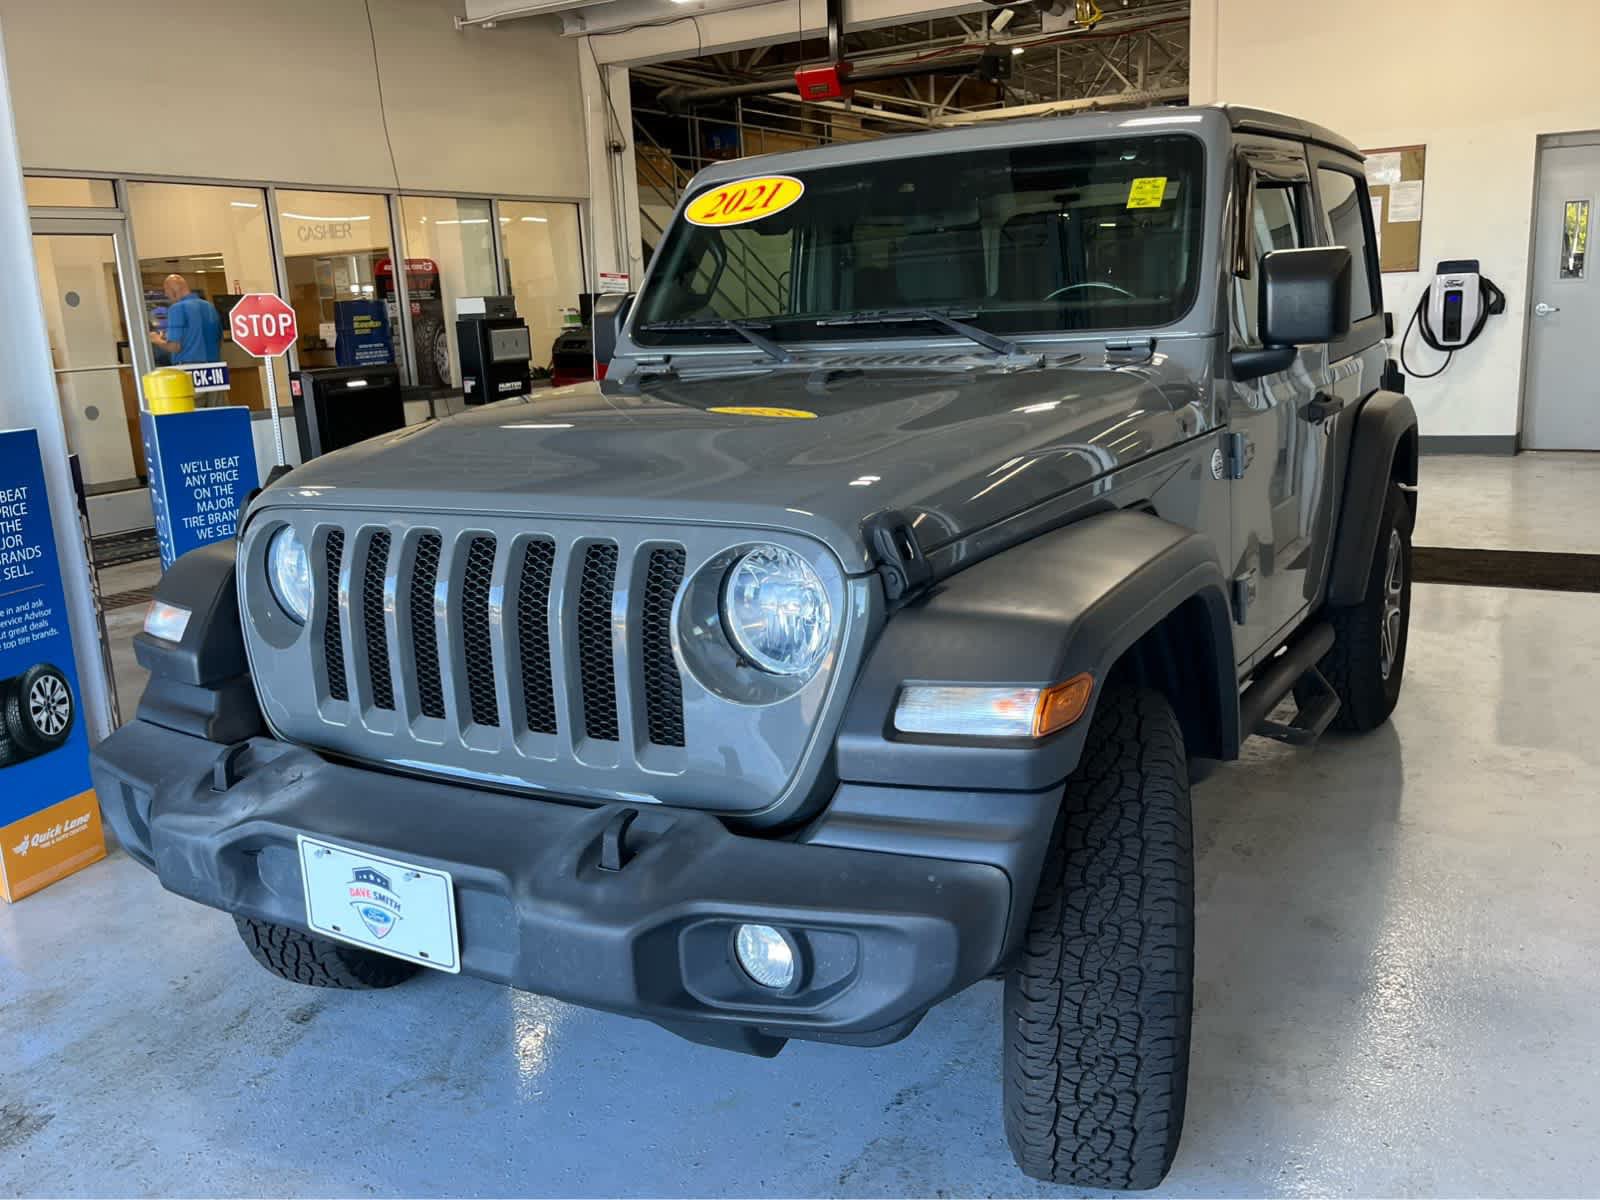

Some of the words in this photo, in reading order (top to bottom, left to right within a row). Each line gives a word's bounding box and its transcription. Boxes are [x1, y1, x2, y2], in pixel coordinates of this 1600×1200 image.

[702, 182, 783, 218] 2021
[297, 222, 353, 242] CASHIER
[1443, 279, 1465, 288] Ford
[234, 313, 292, 338] STOP
[180, 460, 212, 474] WE'LL
[214, 456, 240, 470] BEAT
[185, 474, 207, 488] ANY
[210, 469, 240, 483] PRICE
[0, 486, 28, 503] BEAT
[193, 488, 211, 500] ON
[212, 484, 234, 497] THE
[0, 502, 28, 518] RICE
[196, 496, 235, 513] MAJOR
[0, 518, 23, 534] THE
[182, 515, 206, 529] TIRE
[196, 526, 214, 540] WE
[0, 544, 42, 566] RANDS
[3, 563, 34, 580] SELL.
[6, 607, 14, 616] in
[15, 601, 30, 613] and
[31, 598, 44, 609] ask
[24, 608, 52, 621] Advisor
[8, 624, 28, 640] great
[29, 618, 49, 631] deals
[3, 640, 17, 650] top
[31, 823, 62, 848] Quick
[63, 811, 91, 833] Lane
[349, 887, 372, 899] DAVE
[372, 890, 401, 913] SMITH
